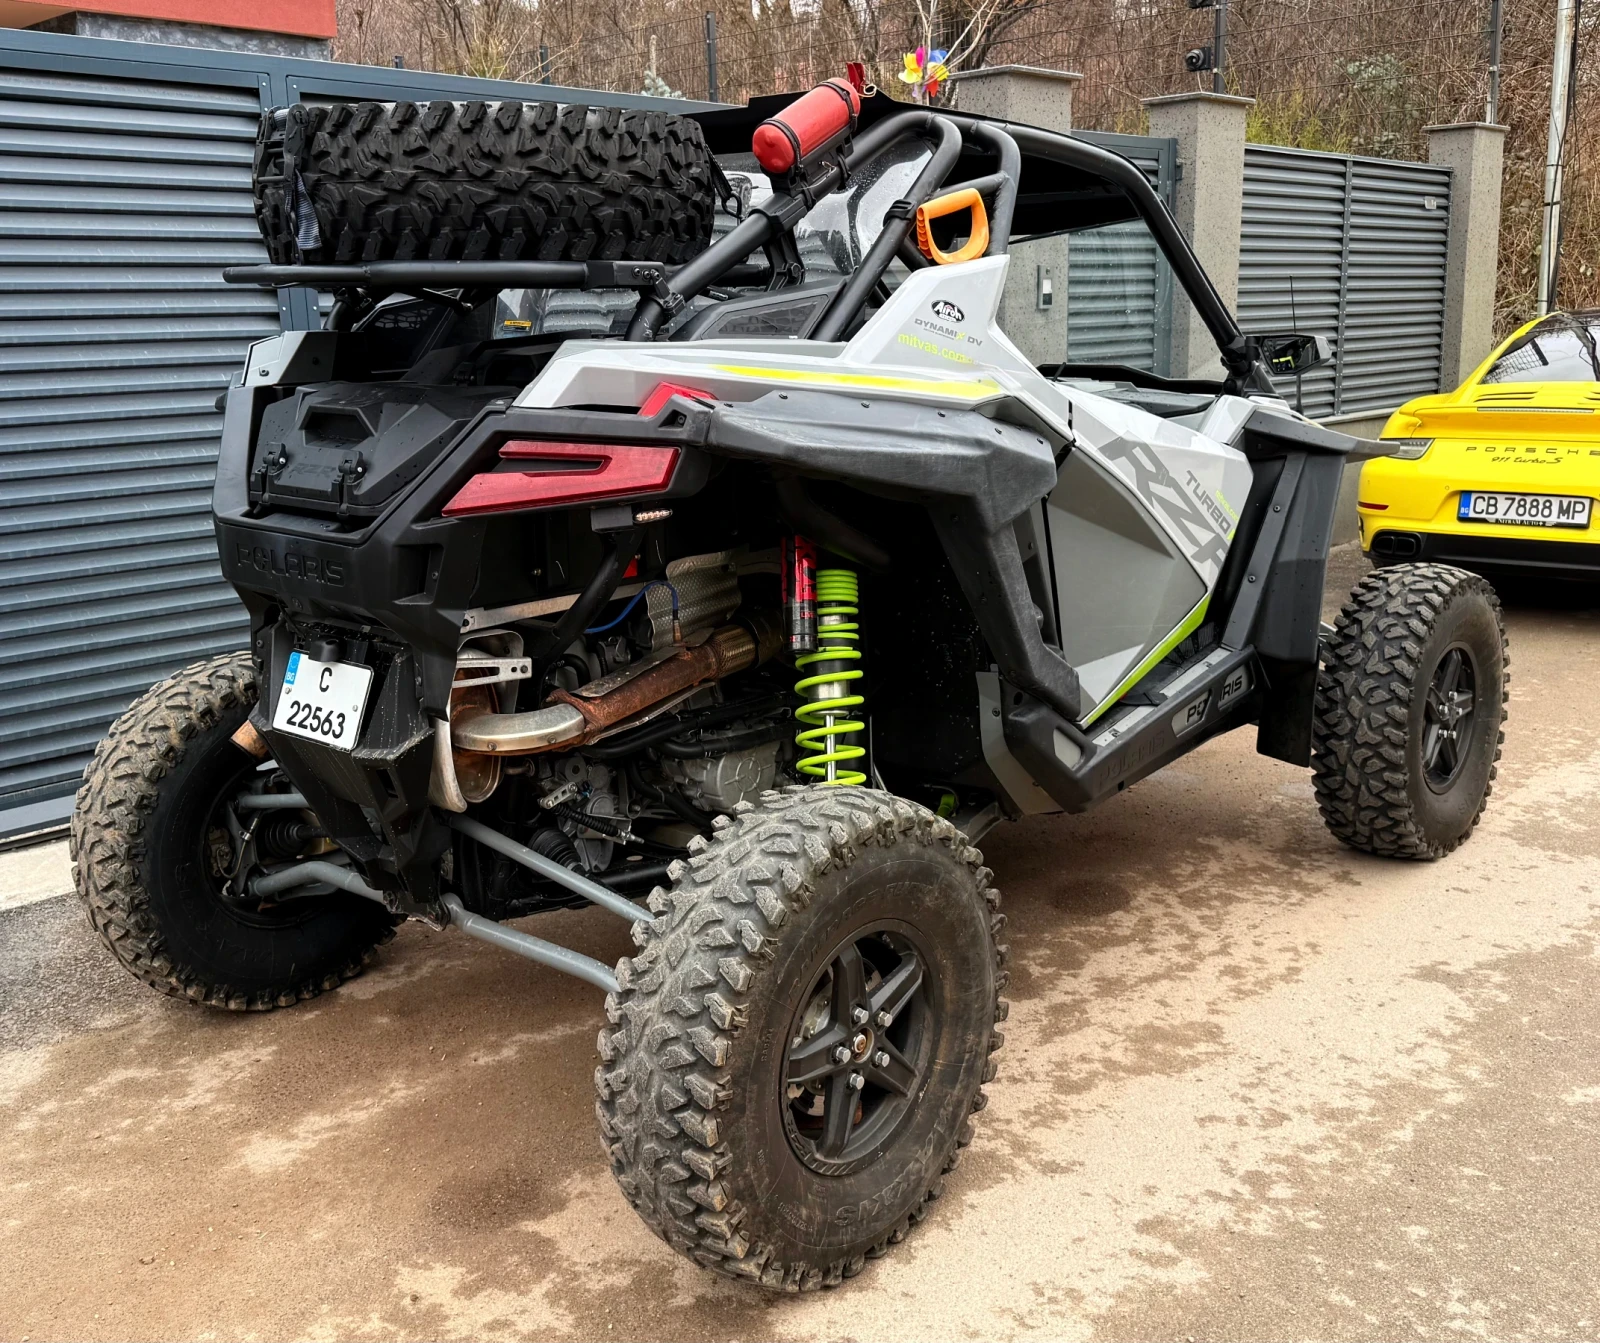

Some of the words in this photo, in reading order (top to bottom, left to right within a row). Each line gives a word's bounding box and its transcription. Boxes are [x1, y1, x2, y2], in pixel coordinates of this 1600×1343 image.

[933, 301, 962, 320] Airoh
[914, 318, 966, 341] DYNAMIX
[967, 335, 983, 347] DV
[1465, 446, 1600, 456] PORSCHE
[1186, 469, 1231, 535] TURBO
[1472, 495, 1498, 515] CB
[1502, 496, 1553, 518] 7888
[1556, 499, 1586, 521] MP
[236, 542, 345, 588] POLARIS
[285, 672, 296, 682] BG
[319, 667, 333, 692] C
[286, 700, 346, 739] 22563
